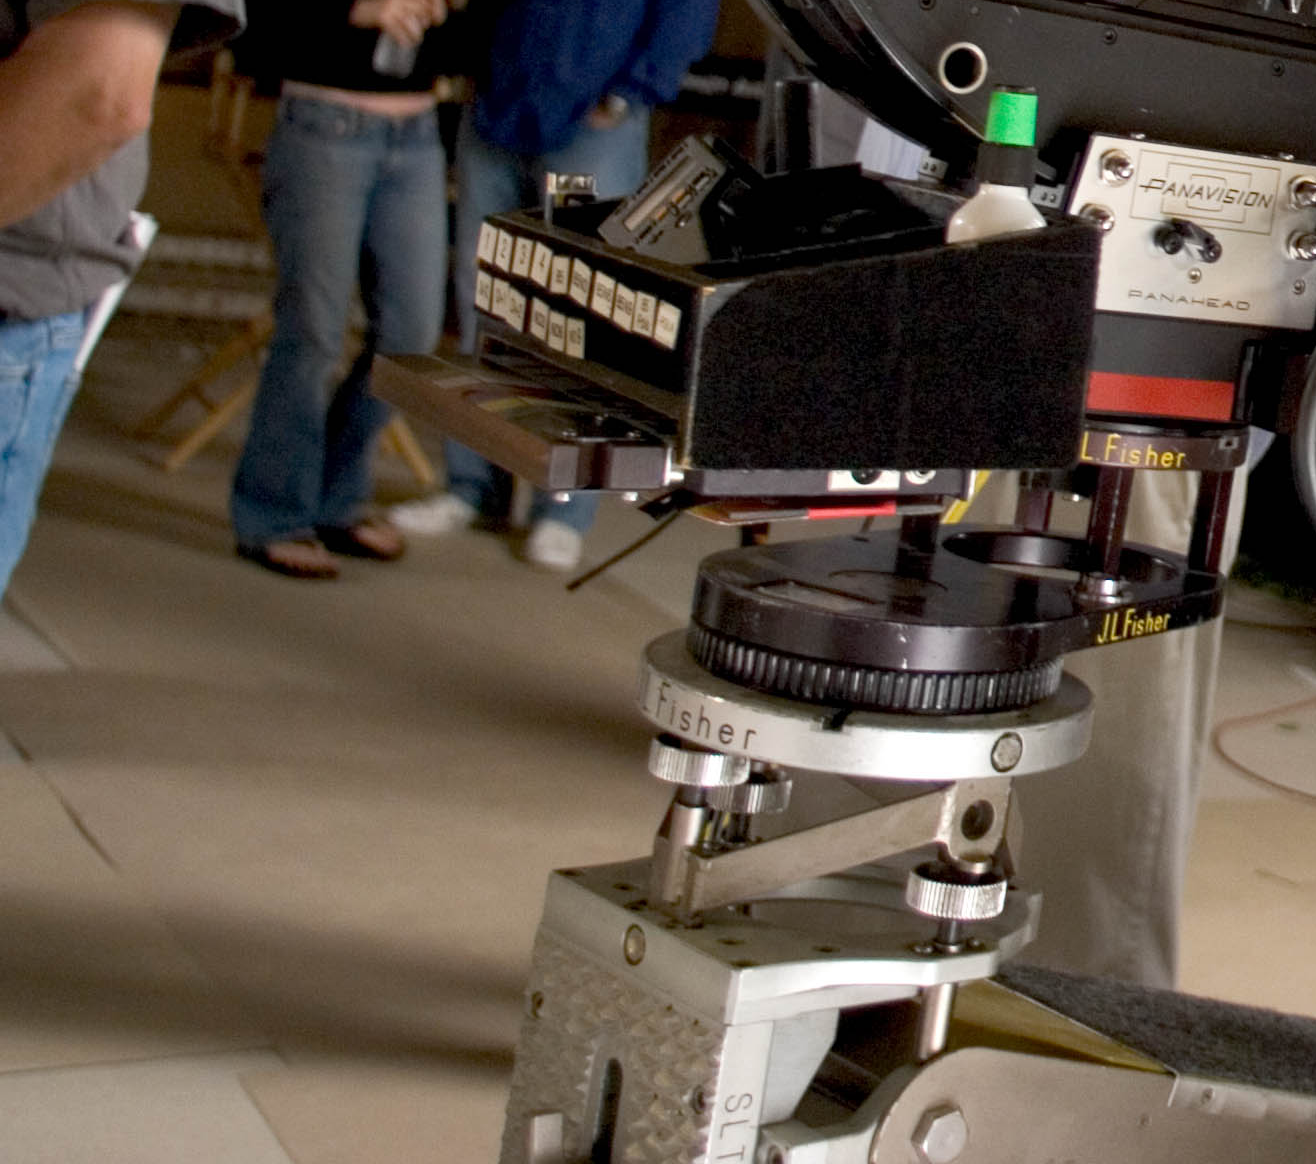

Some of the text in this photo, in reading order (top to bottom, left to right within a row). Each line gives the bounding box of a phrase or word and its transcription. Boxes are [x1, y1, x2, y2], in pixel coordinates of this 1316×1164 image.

[1138, 178, 1274, 209] PANAVISION
[1127, 289, 1251, 311] PANAHEAD
[656, 681, 757, 750] Fisher
